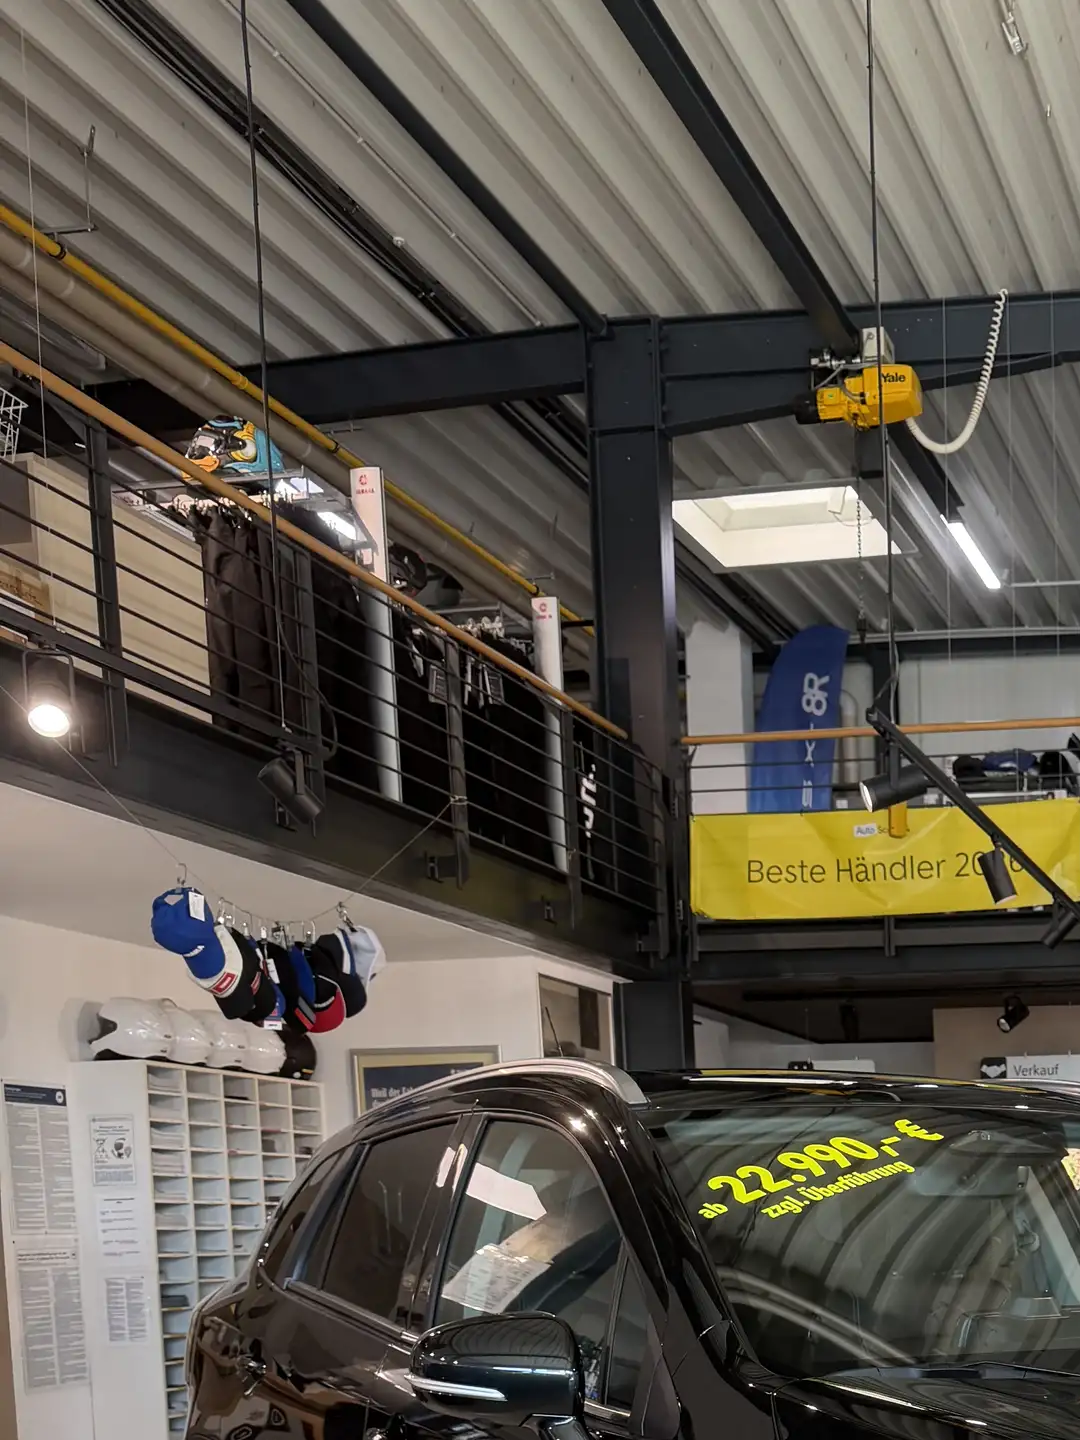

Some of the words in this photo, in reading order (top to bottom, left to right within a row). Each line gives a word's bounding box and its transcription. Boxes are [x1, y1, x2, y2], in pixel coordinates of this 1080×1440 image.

[881, 373, 906, 383] Yale
[747, 859, 826, 884] Beste
[836, 855, 946, 883] Händler
[955, 850, 1026, 878] 206
[1013, 1063, 1060, 1077] Verkauf
[761, 1195, 811, 1219] zzgl.
[796, 1161, 916, 1202] Überführung
[698, 1203, 728, 1219] ab
